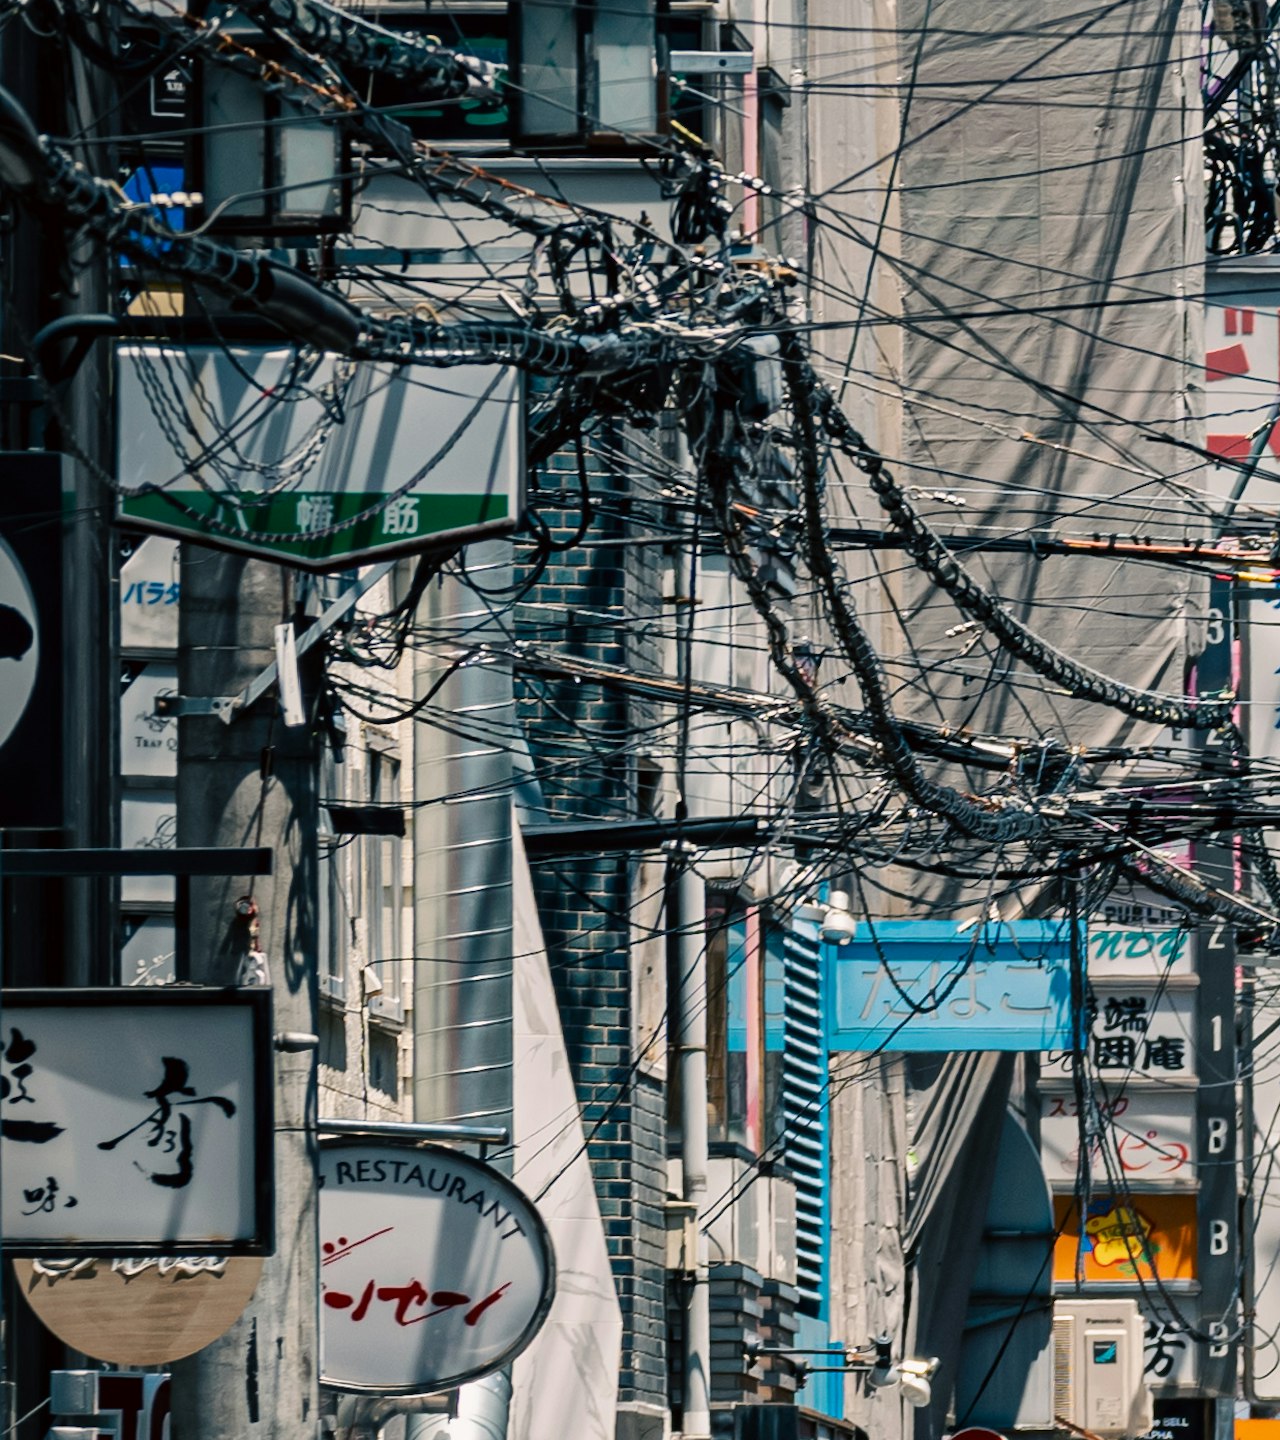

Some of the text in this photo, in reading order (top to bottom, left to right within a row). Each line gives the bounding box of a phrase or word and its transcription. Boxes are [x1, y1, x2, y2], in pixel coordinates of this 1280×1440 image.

[857, 960, 1055, 1021] たばこ
[1210, 1015, 1223, 1052] 1
[335, 1158, 528, 1244] RESTAURANT
